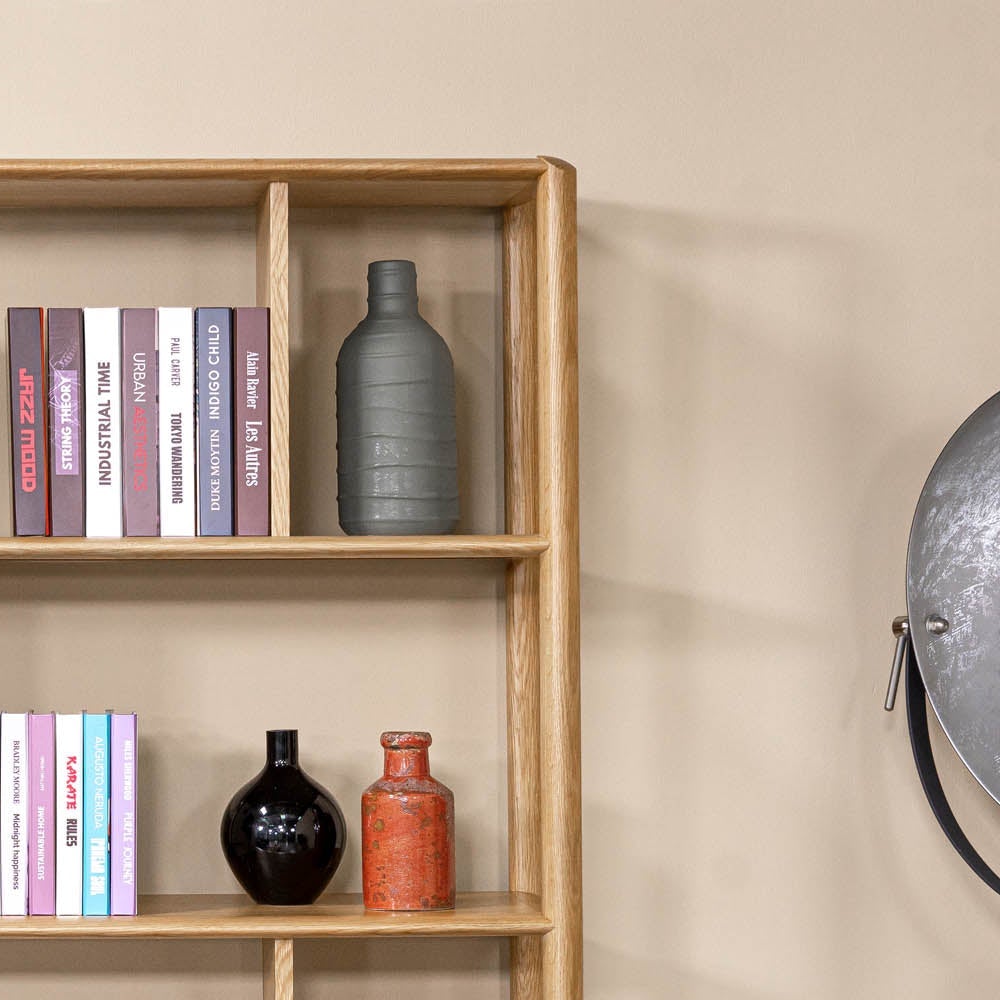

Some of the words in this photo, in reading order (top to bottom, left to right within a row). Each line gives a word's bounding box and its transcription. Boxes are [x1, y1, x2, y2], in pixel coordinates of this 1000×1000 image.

[170, 337, 180, 355] PAUL
[208, 324, 220, 363] CHILD
[246, 351, 259, 376] Alain
[97, 361, 111, 397] TIME
[132, 352, 146, 403] URBAN
[171, 359, 181, 386] CARVER
[19, 367, 35, 425] JAZZ
[60, 377, 73, 424] THEORY
[208, 369, 220, 420] INDIGO
[246, 378, 259, 409] Ravier
[61, 426, 73, 470] STRING
[98, 399, 112, 486] INDUSTRIAL
[170, 412, 183, 445] TOKYO
[246, 420, 262, 442] Les
[20, 429, 37, 493] MOOD
[133, 406, 148, 493] AESTHETICS
[210, 429, 220, 476] MOYTIN
[246, 444, 262, 487] Autres
[171, 446, 184, 504] WANDERING
[210, 478, 221, 511] DUKE
[94, 736, 104, 785] AUGUSTO
[66, 755, 77, 810] KARATE
[37, 806, 45, 828] HOME
[94, 788, 104, 829] NERUDA
[11, 813, 20, 848] Midnight
[66, 818, 77, 847] RULES
[11, 850, 20, 890] happiness
